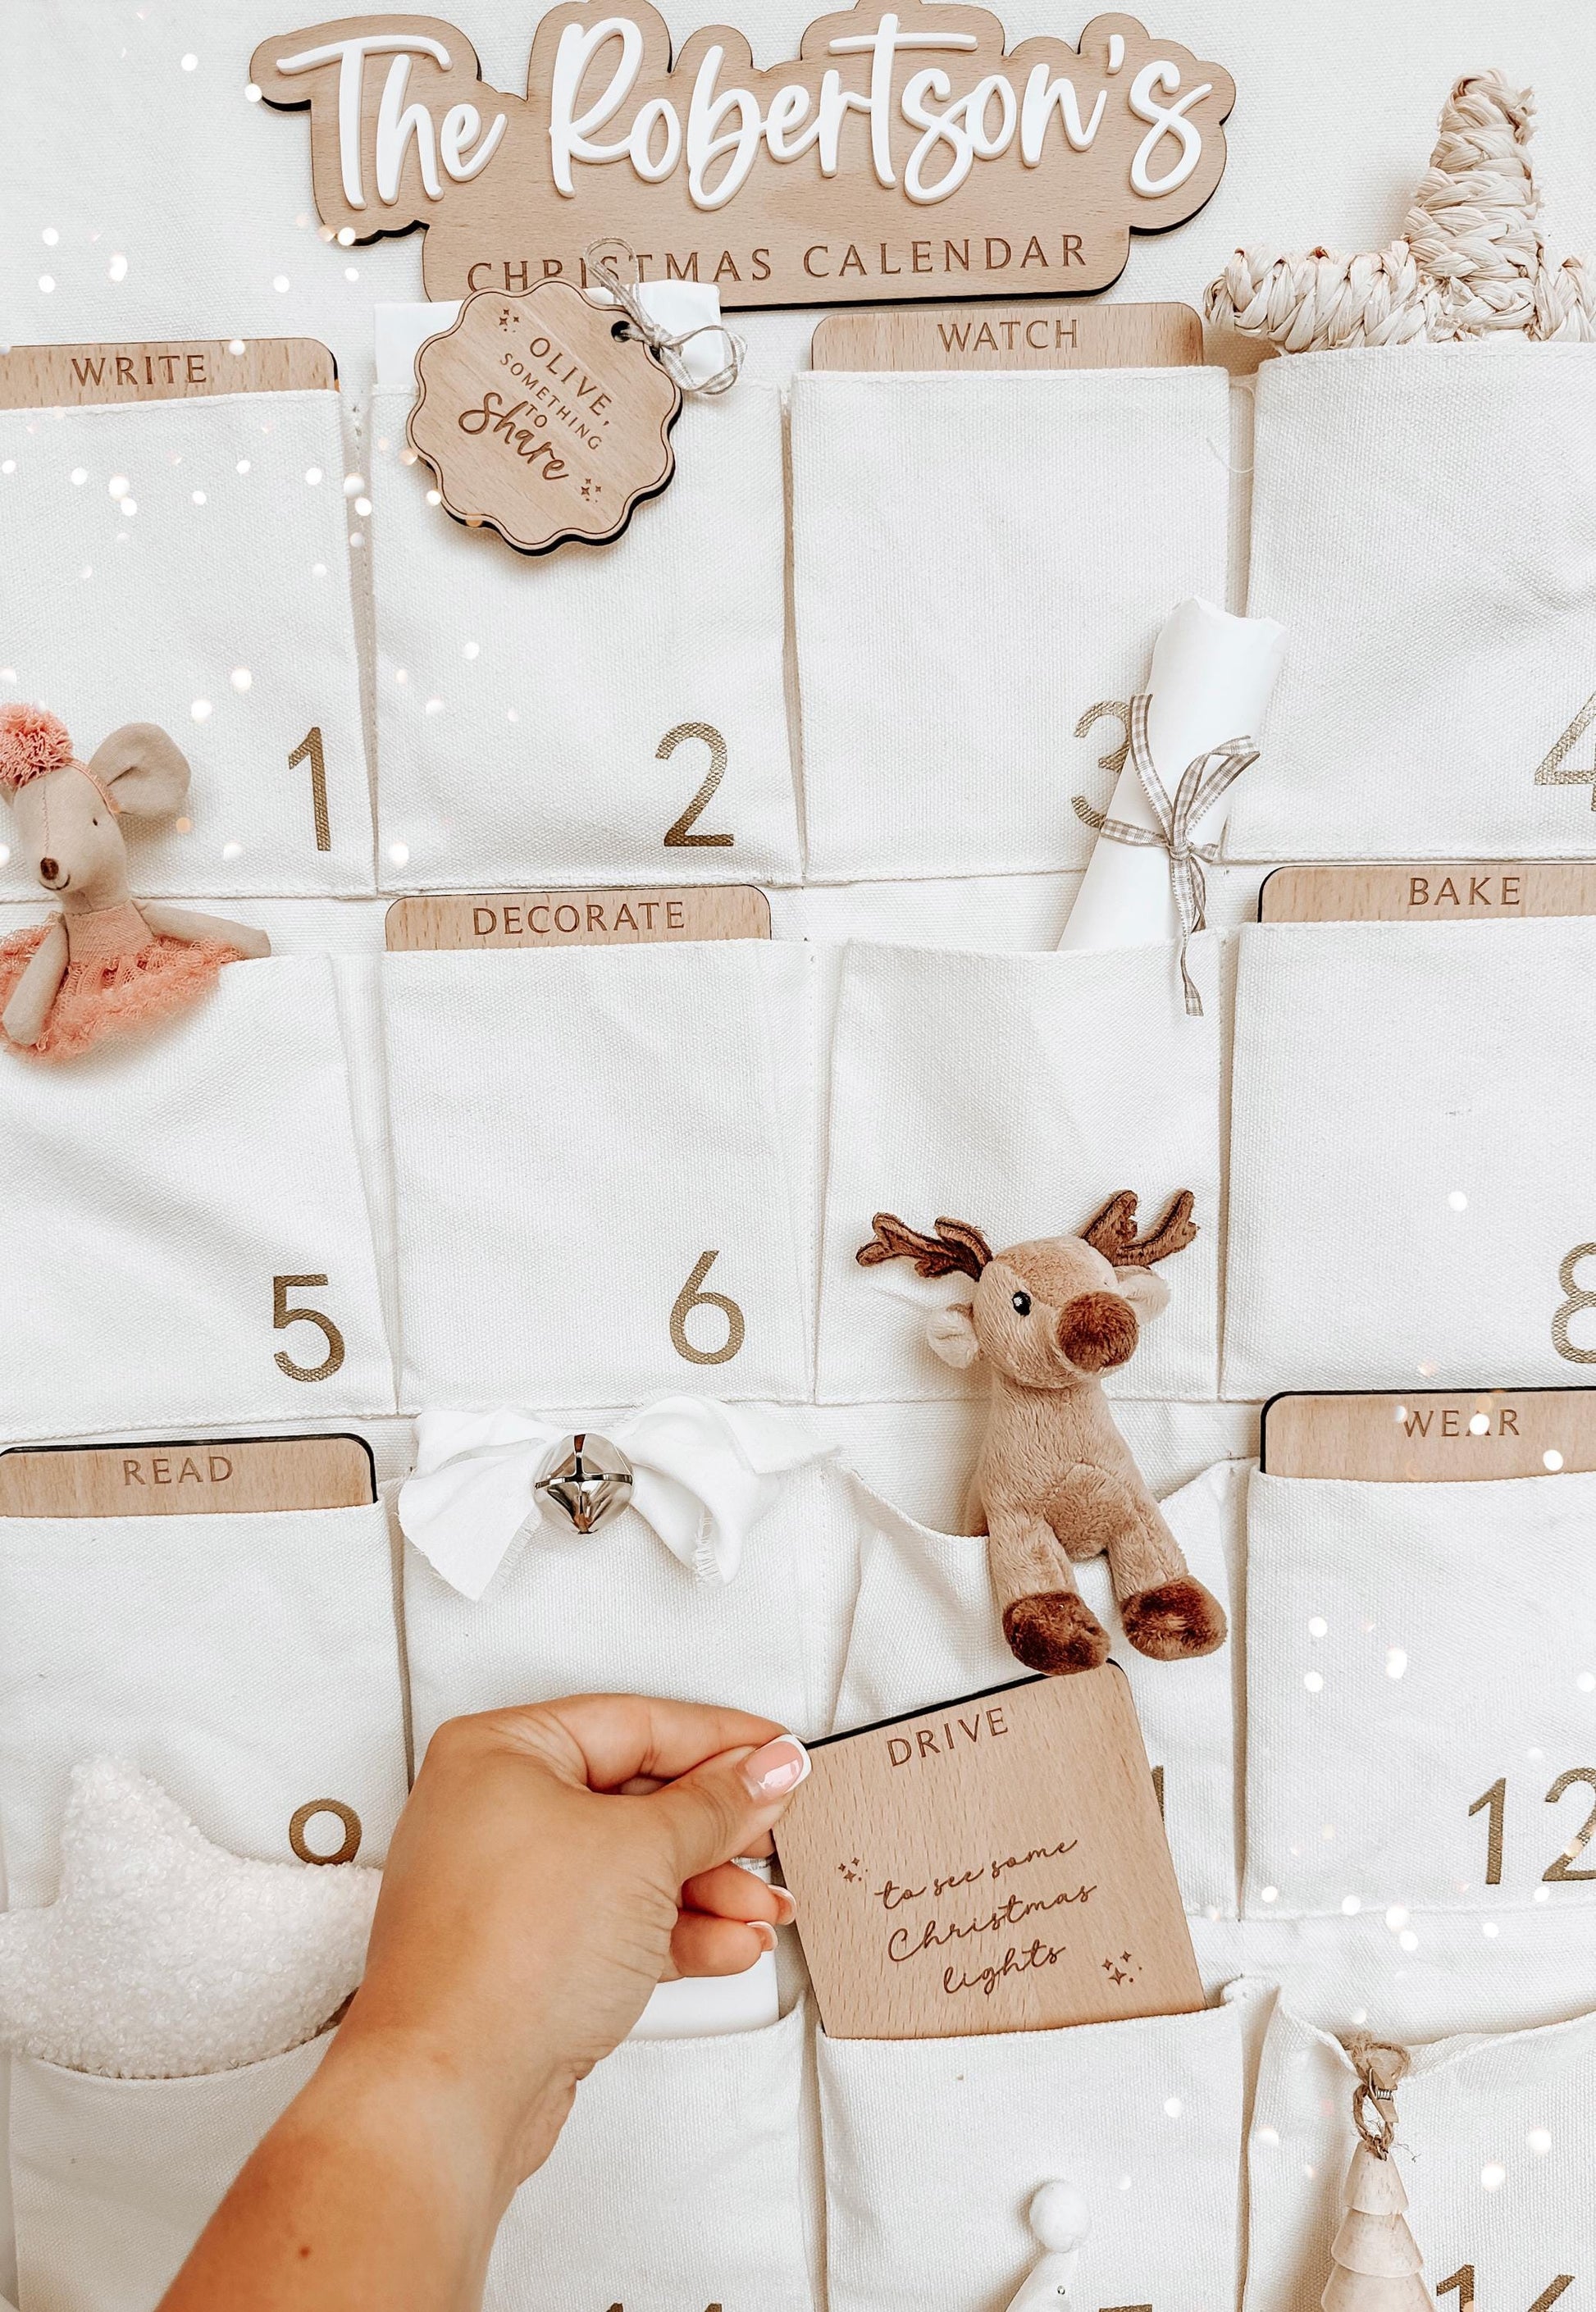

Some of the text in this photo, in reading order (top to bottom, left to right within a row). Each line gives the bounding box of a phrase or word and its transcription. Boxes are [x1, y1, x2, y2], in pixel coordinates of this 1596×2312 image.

[276, 13, 1213, 212] The Robertson's
[803, 234, 1087, 279] CALENDAR
[71, 354, 207, 386] WRITE
[937, 319, 1078, 352] WATCH
[500, 353, 603, 450] SOMETHING
[526, 403, 548, 429] TO
[530, 337, 613, 426] OLIVE,
[458, 392, 570, 481] Share
[288, 726, 331, 852] 1
[655, 722, 734, 847] 2
[473, 901, 685, 936] DECORATE
[1408, 877, 1521, 906] BAKE
[272, 1273, 345, 1383] 5
[669, 1250, 746, 1365] 6
[123, 1456, 234, 1485] READ
[887, 1708, 1009, 1767] DRIVE
[1468, 1767, 1596, 1885] 12
[874, 1839, 1078, 1910] to see some
[887, 1885, 1097, 1963] Christmas
[943, 1939, 1066, 1995] lights
